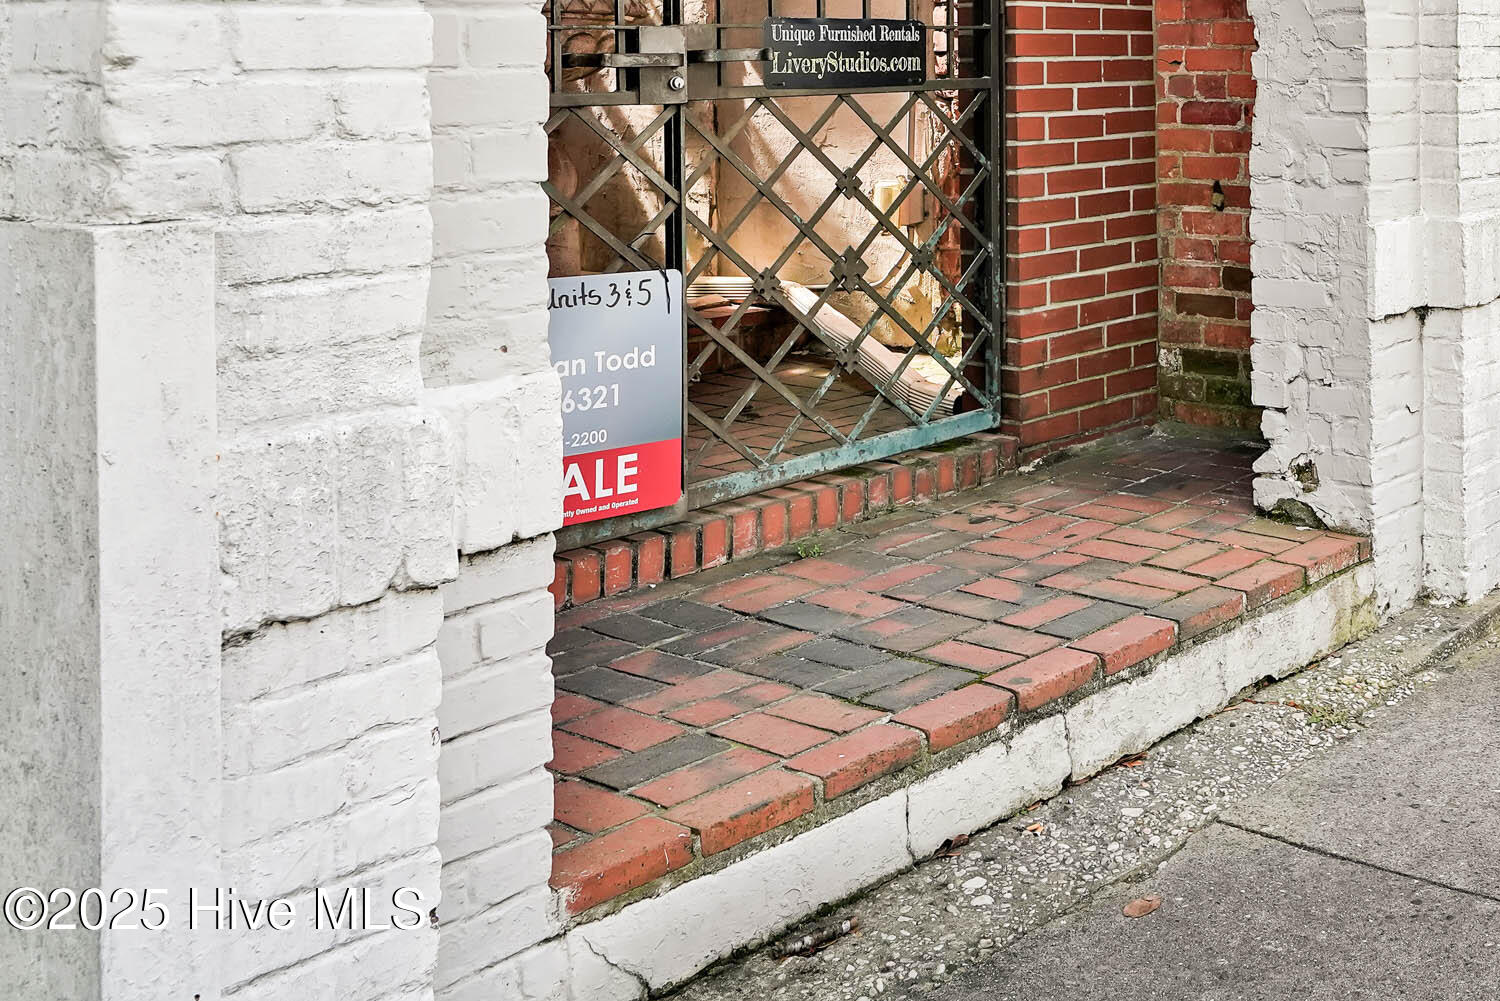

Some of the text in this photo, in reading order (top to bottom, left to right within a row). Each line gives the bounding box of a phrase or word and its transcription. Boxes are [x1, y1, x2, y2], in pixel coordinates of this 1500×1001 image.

[771, 24, 920, 46] Unique Furnished Rentals
[770, 50, 922, 80] LiveryStudios.com
[553, 345, 656, 377] an Todd
[562, 383, 619, 413] 6321
[565, 429, 608, 447] -2200
[563, 452, 638, 501] ALE
[562, 498, 639, 518] ntly Owned and Operated
